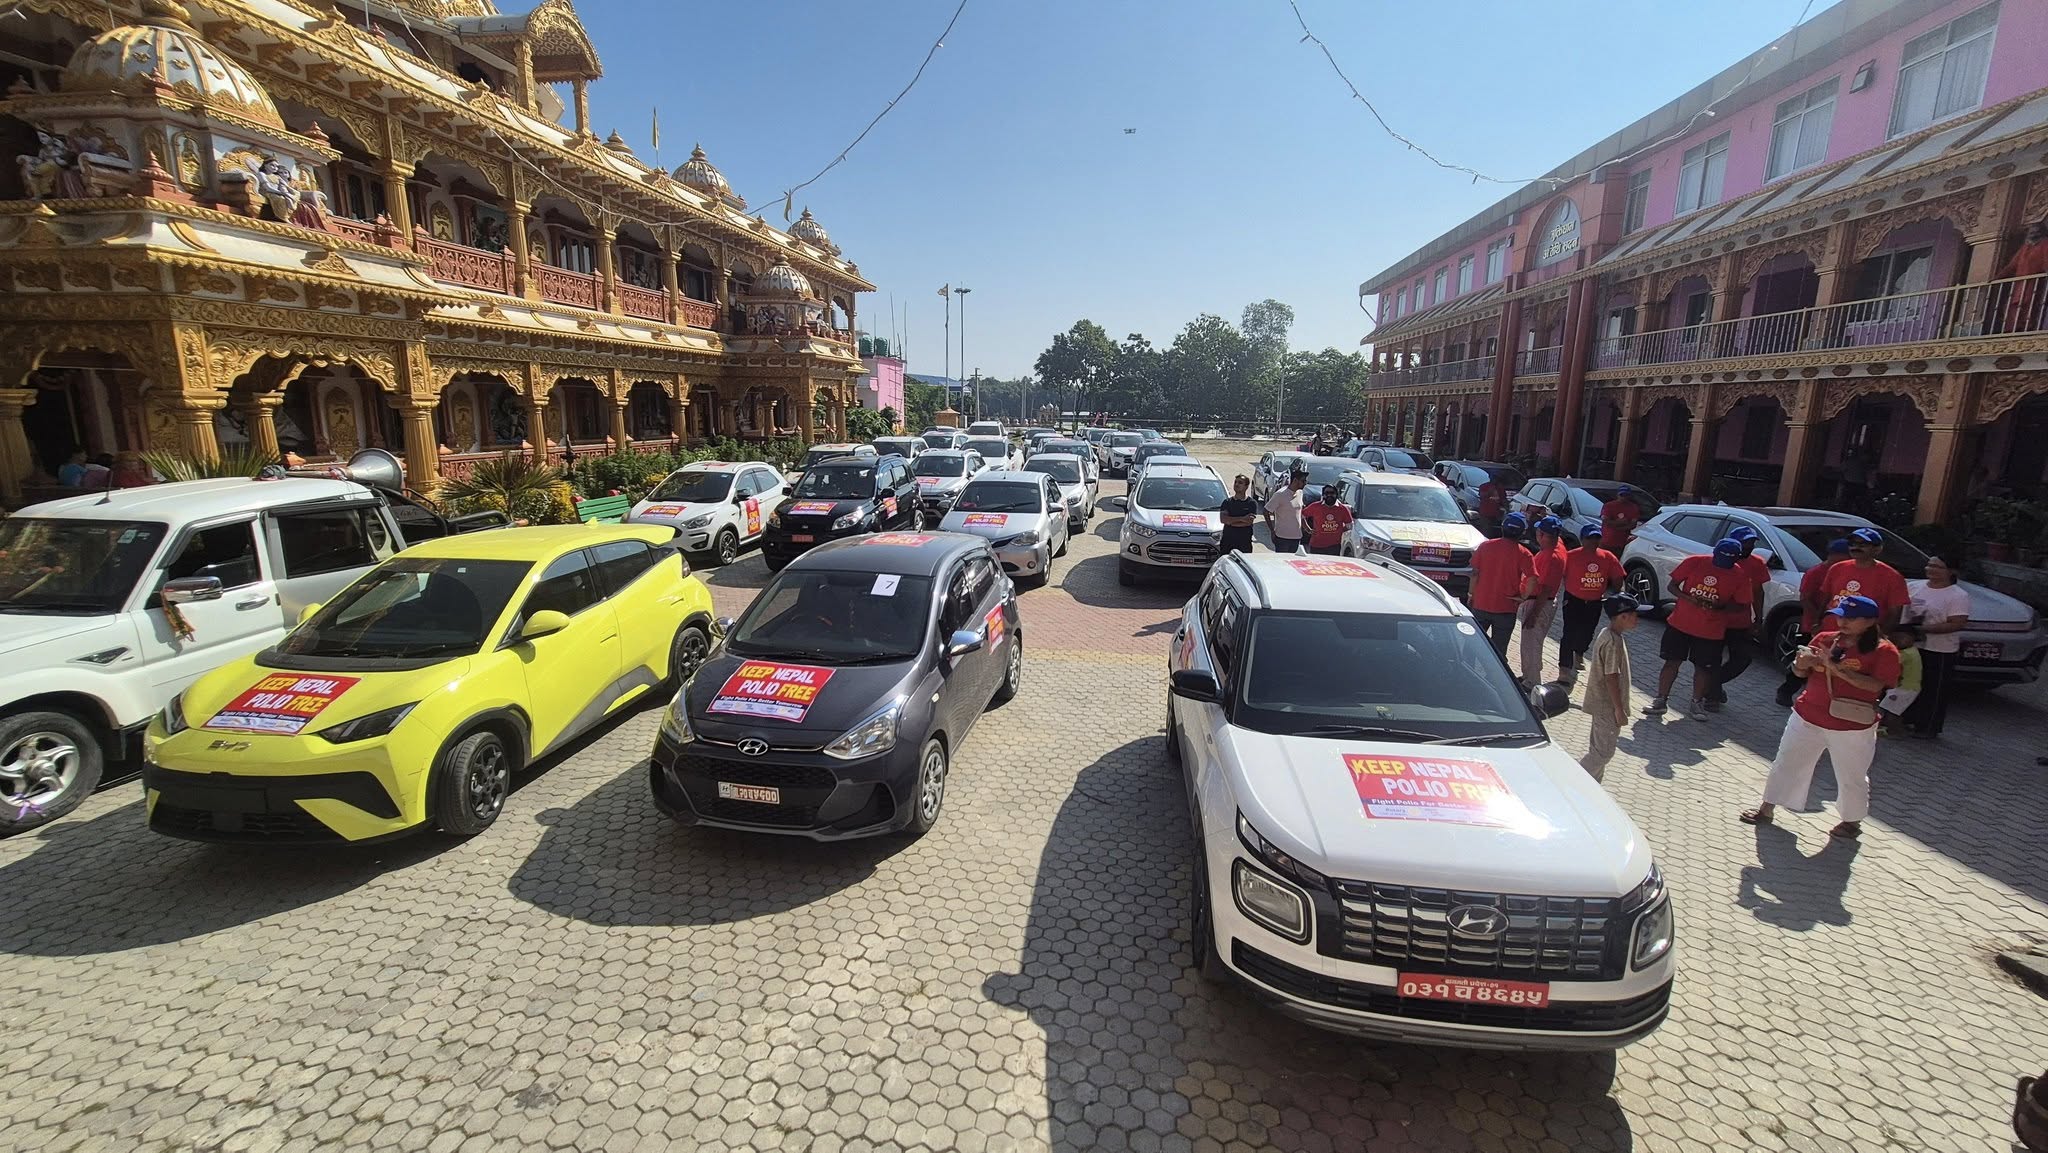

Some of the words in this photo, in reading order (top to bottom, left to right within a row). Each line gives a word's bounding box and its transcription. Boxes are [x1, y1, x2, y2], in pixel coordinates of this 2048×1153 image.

[1418, 547, 1434, 555] POLIO
[1696, 584, 1717, 594] END
[738, 666, 775, 679] KEEP
[772, 668, 815, 683] NEPAL
[252, 677, 297, 691] KEEP
[288, 678, 339, 694] NEPAL
[738, 680, 780, 696] POLIO
[776, 684, 816, 701] FREE
[243, 692, 294, 708] POLIO
[282, 695, 331, 713] FREE
[1351, 759, 1406, 776] KEEP
[1408, 762, 1482, 781] NEPAL
[1382, 778, 1449, 798] POLIO
